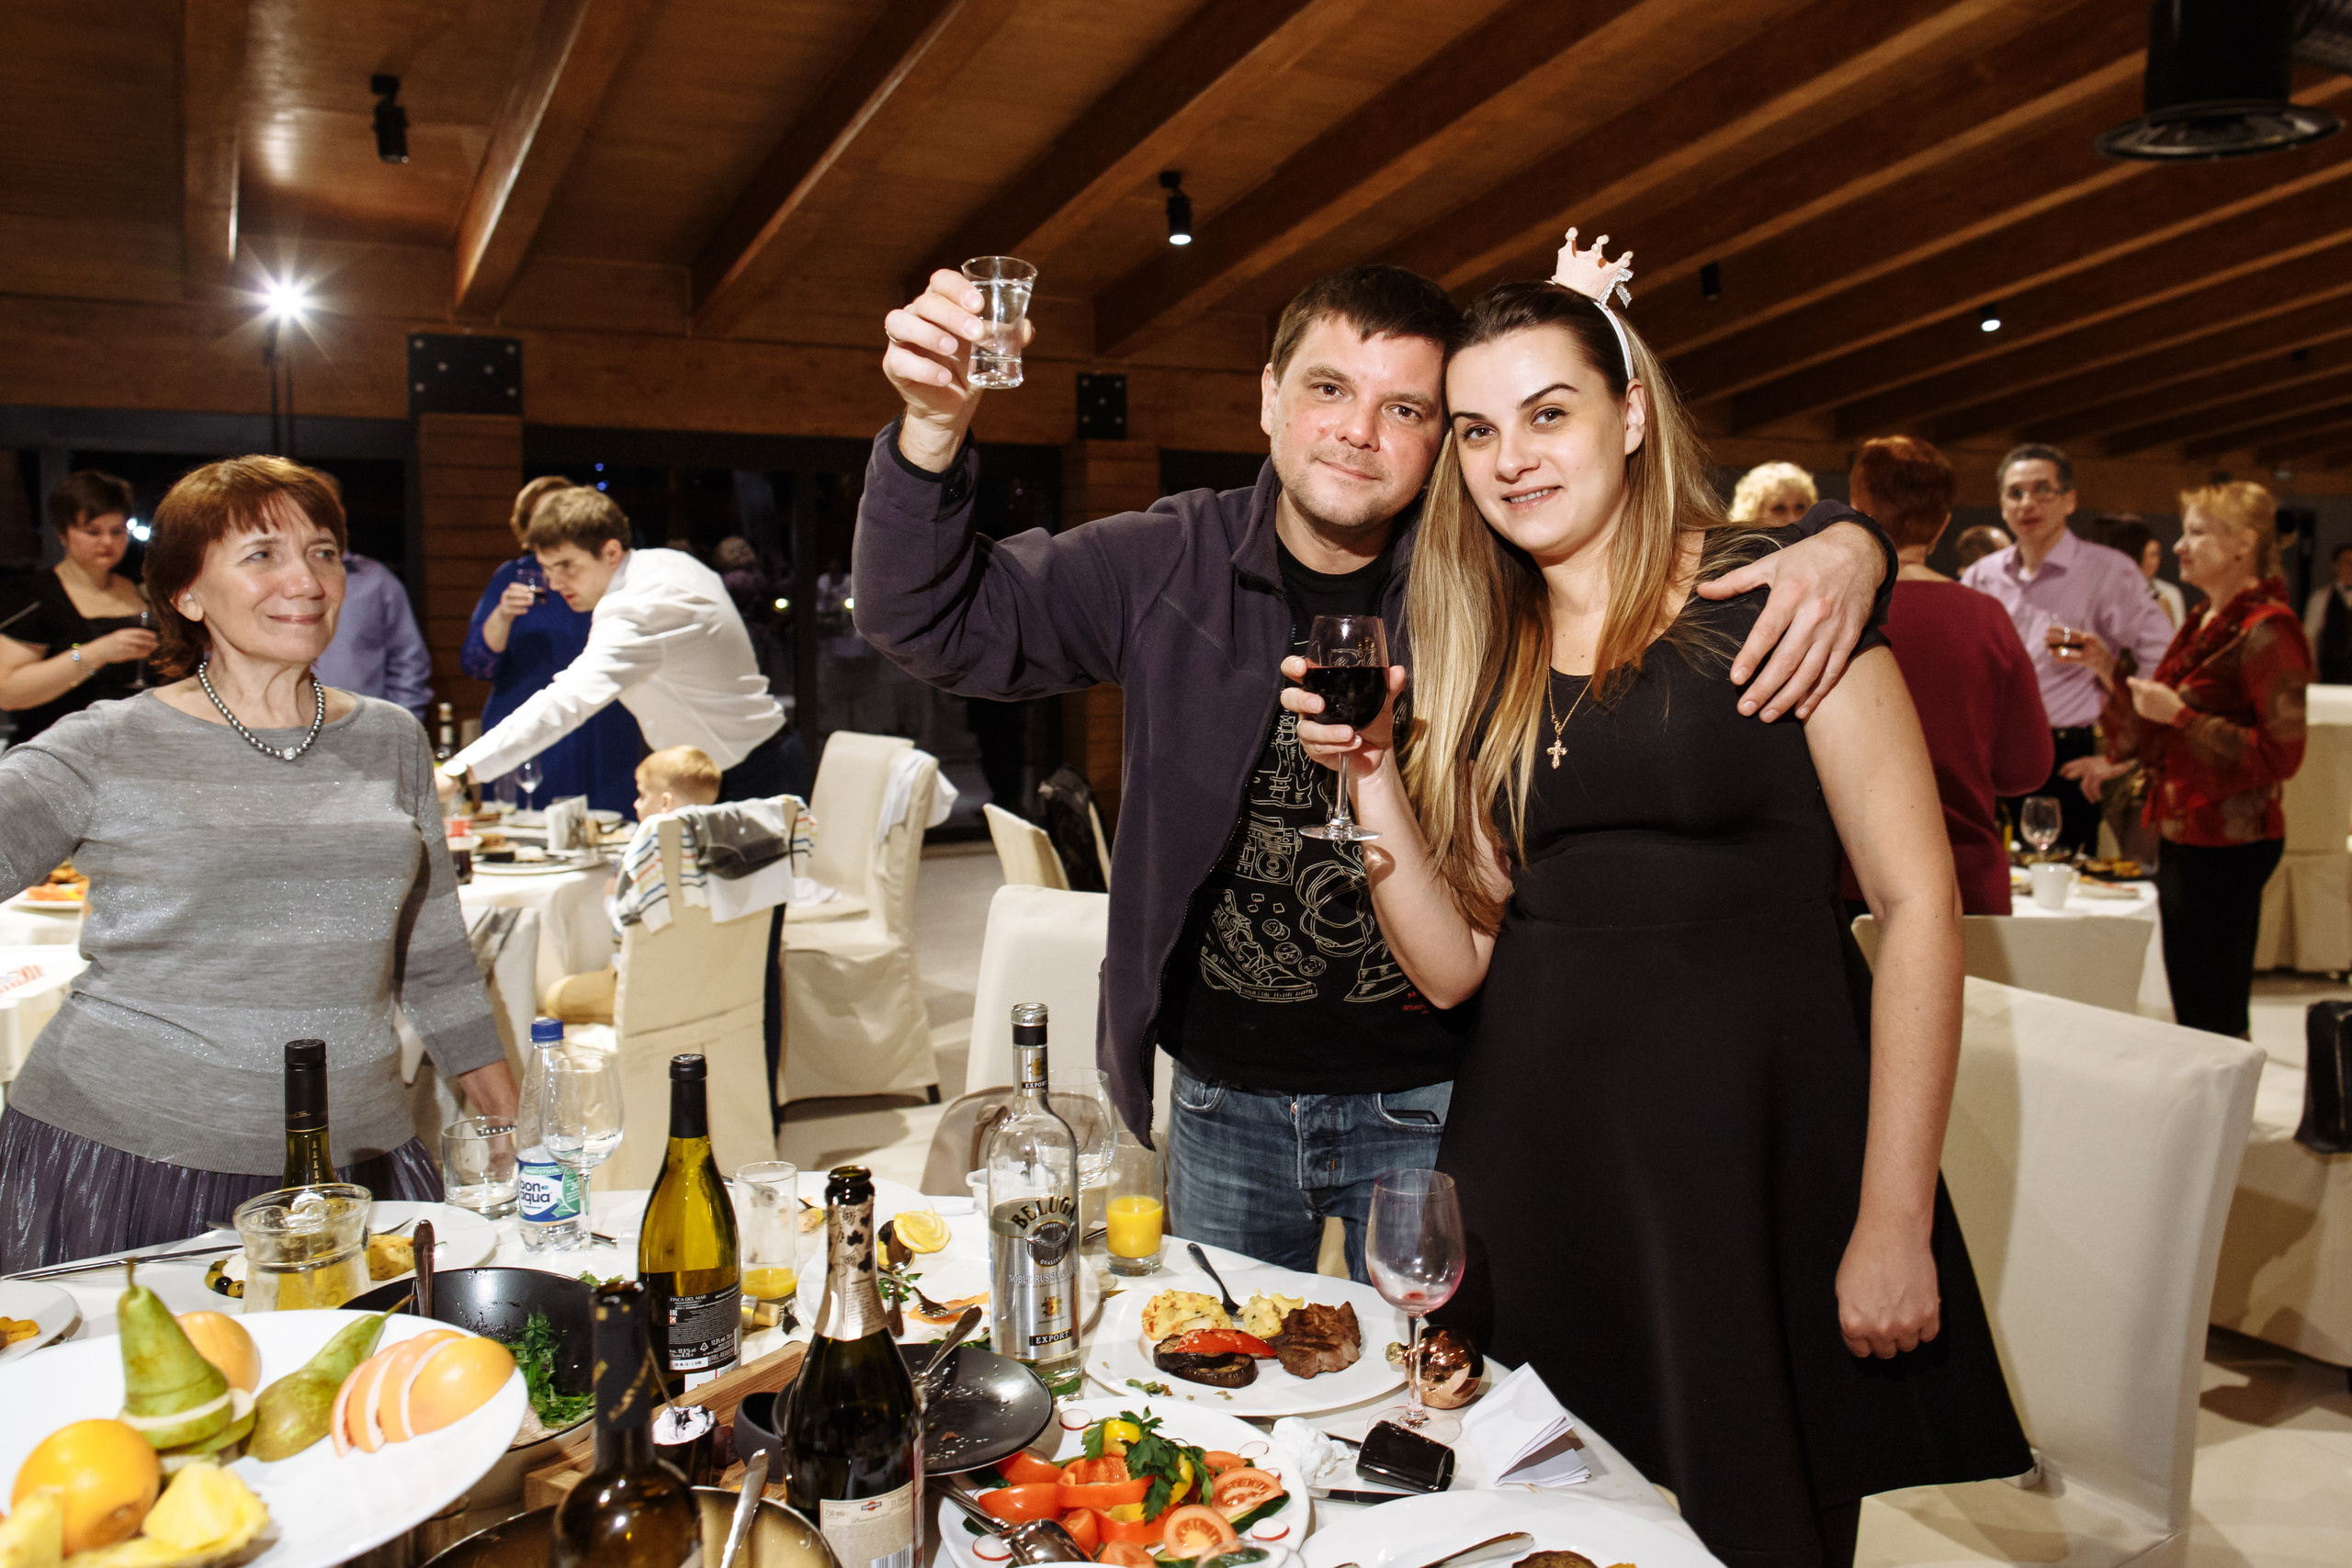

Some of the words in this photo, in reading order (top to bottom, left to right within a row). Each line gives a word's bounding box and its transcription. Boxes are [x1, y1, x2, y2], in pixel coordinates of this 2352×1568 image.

[1012, 1196, 1077, 1230] BELUGA
[1040, 1256, 1061, 1265] QUALITY
[1009, 1273, 1033, 1284] NOBLE
[1035, 1269, 1065, 1283] RUSSIAN
[1035, 1330, 1069, 1344] EXPORT
